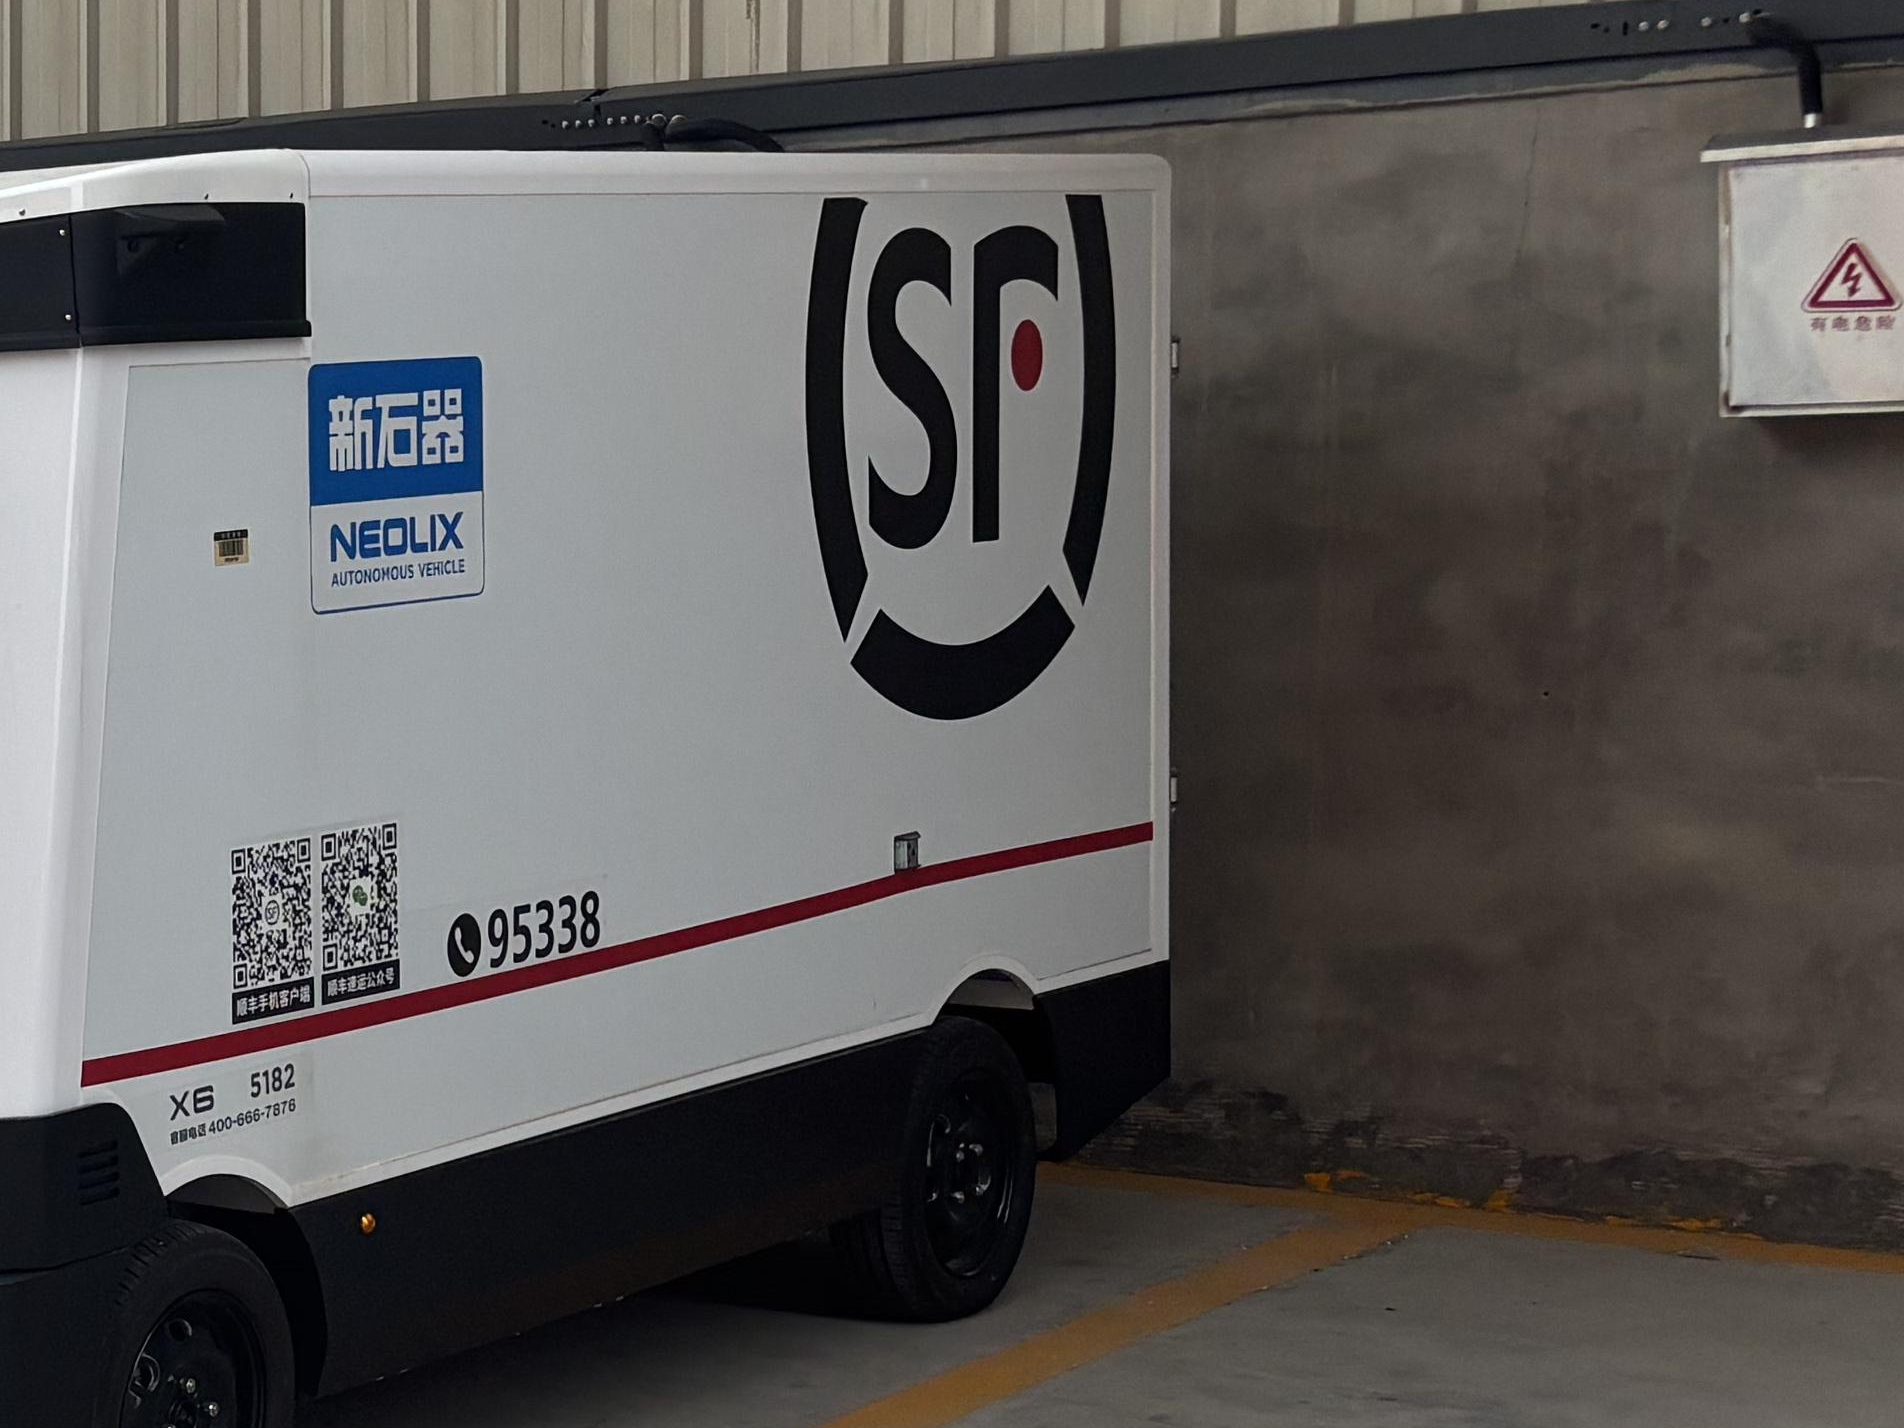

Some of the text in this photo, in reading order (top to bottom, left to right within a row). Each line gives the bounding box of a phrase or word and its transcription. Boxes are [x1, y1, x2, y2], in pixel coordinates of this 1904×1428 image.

[867, 225, 1060, 550] SF
[328, 388, 464, 472] 新石器
[330, 511, 464, 563] NEOLIX
[331, 558, 465, 587] AUTONOMOUS VEHICLE
[487, 890, 600, 968] 95338
[236, 984, 311, 1017] 顺丰手机客户端
[169, 1063, 296, 1121] X6 5182
